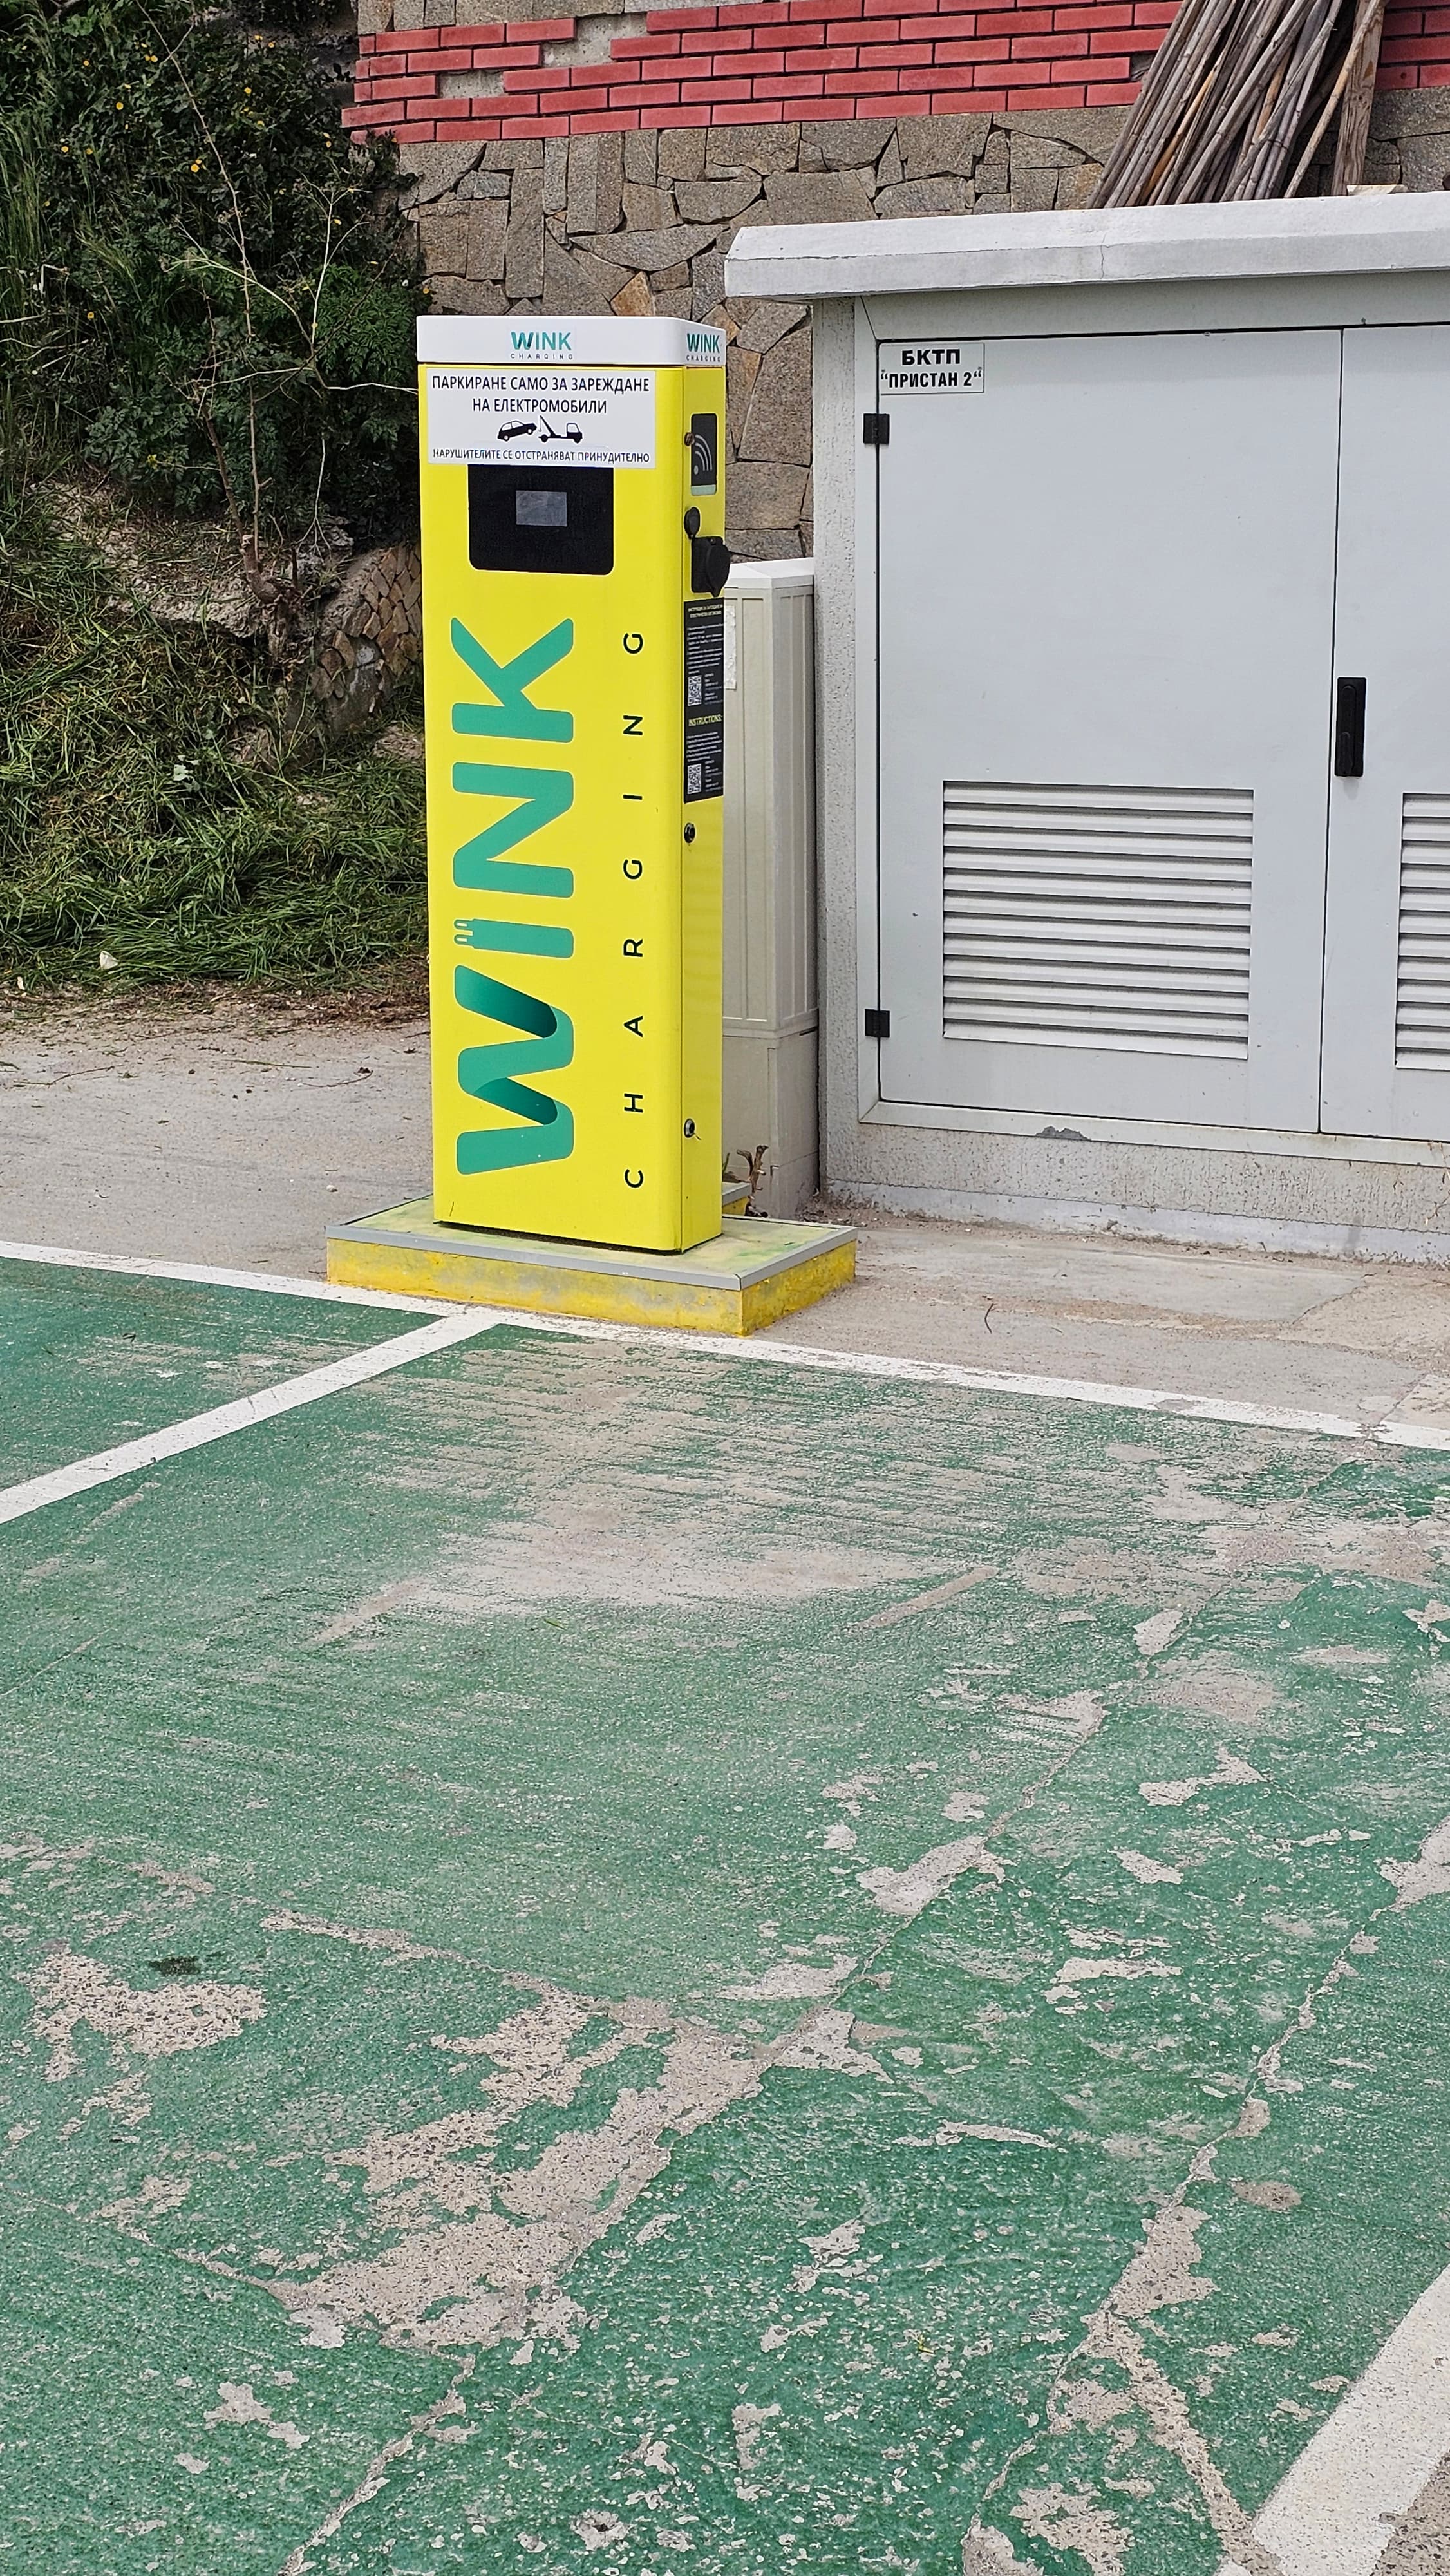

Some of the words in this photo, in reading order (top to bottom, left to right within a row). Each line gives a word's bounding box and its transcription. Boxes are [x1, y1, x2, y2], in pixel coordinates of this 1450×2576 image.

[511, 332, 572, 350] WINK
[686, 333, 720, 354] WINK
[901, 348, 961, 365] БКТП
[432, 375, 507, 390] ПАРКИРАНЕ
[510, 377, 548, 391] САМО
[552, 377, 567, 391] ЗА
[571, 377, 649, 394] ЗАРЕЖДАНЕ
[473, 398, 490, 412] НА
[494, 399, 607, 413] ЕЛЕКТРОМОБИЛИ
[433, 448, 501, 459] НАРУШИТЕЛИТЕ
[502, 450, 513, 459] СЕ
[515, 450, 575, 461] ОТСТРАНЯВАТ
[578, 452, 650, 464] ПРИНУДИТЕЛНО
[451, 617, 574, 1175] WINK
[623, 632, 644, 1188] CHARGING
